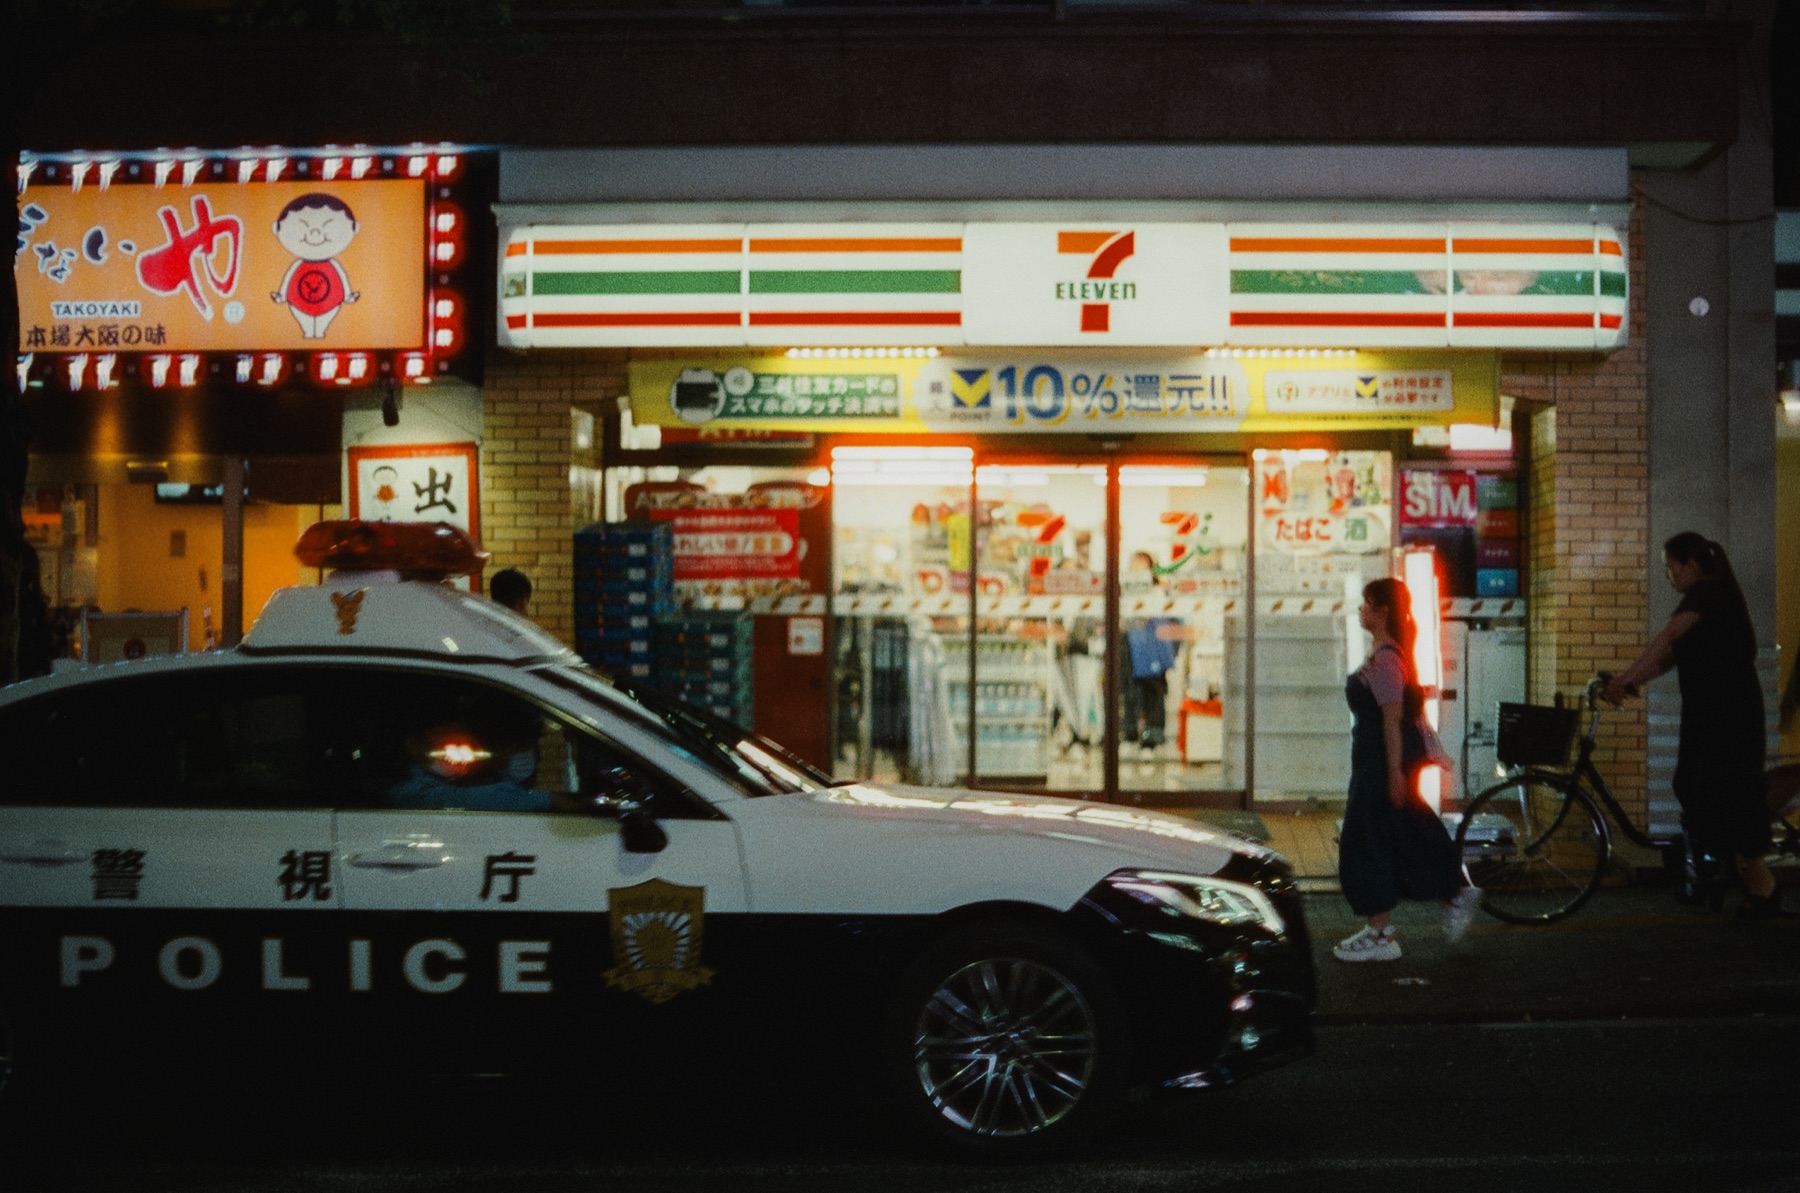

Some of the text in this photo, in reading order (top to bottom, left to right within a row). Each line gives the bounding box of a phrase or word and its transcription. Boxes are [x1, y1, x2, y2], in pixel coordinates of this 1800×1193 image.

[1057, 230, 1135, 332] 7
[53, 303, 139, 316] TAKOYAKI
[26, 323, 167, 347] 本場大阪の味
[412, 466, 457, 514] 出
[1404, 483, 1471, 518] SIM
[1276, 517, 1368, 541] たばこ 酒
[91, 848, 537, 901] 警視庁
[60, 937, 553, 993] POLICE
